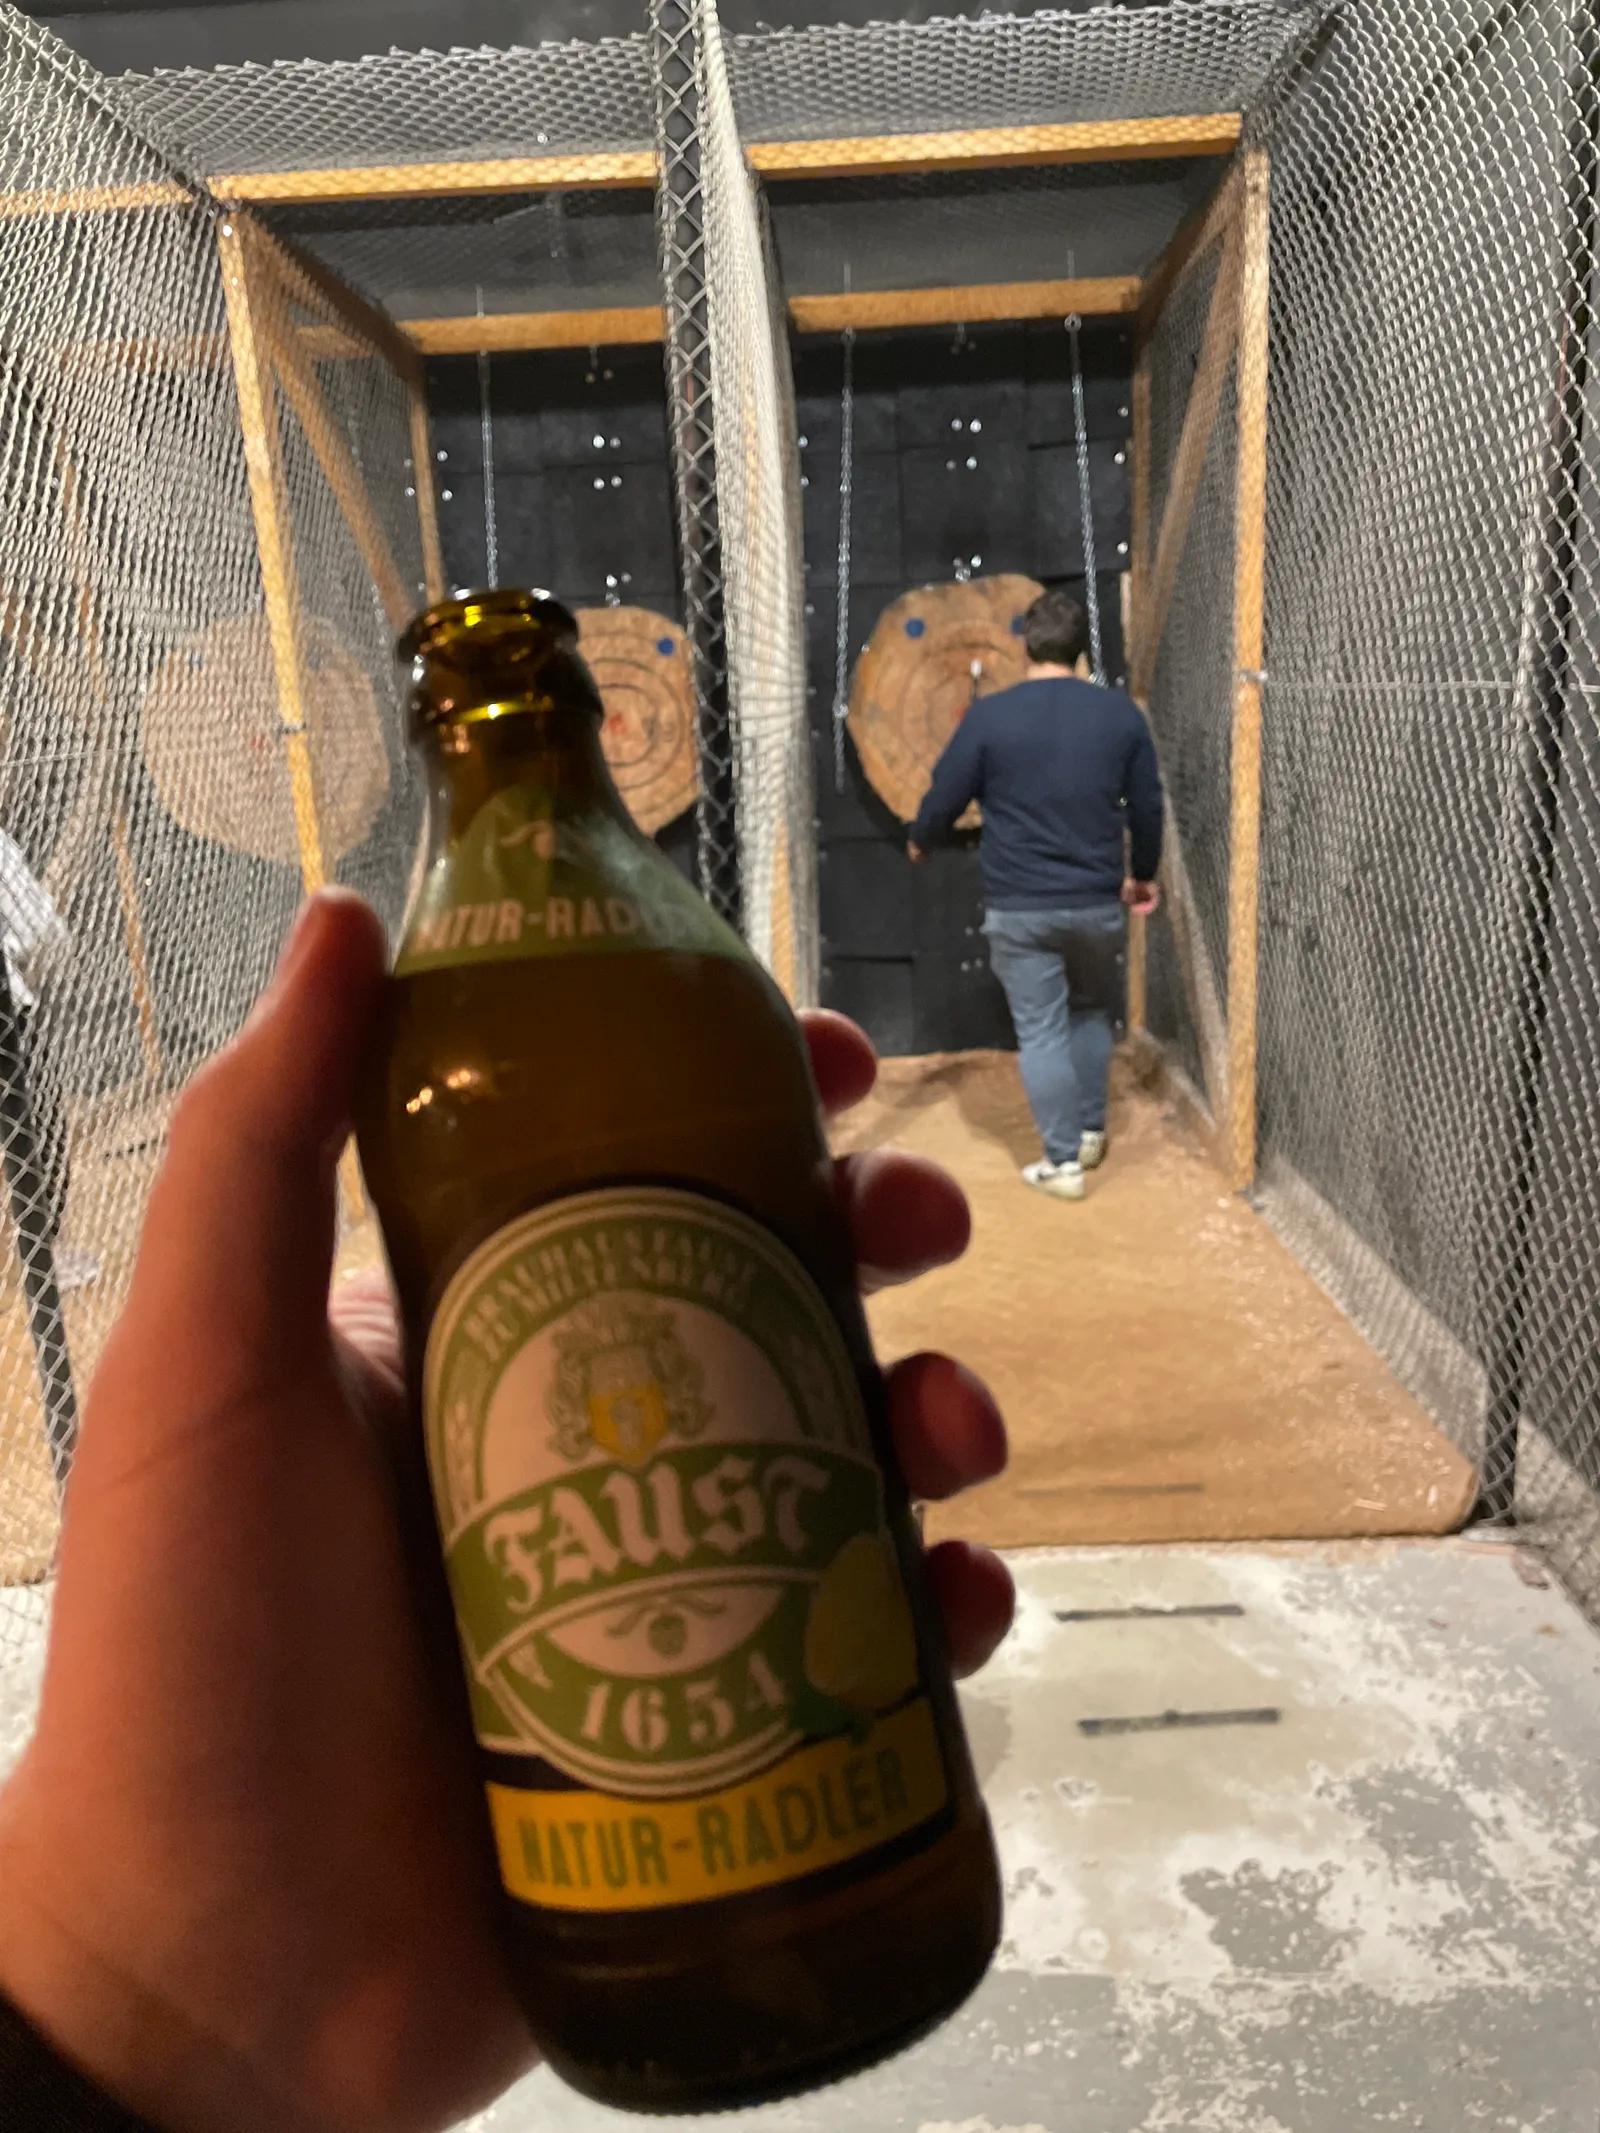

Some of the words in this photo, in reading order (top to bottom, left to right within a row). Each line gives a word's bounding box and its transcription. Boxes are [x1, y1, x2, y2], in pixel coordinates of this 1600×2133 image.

[483, 1456, 830, 1612] FAUST
[581, 1650, 786, 1753] 1654
[515, 1746, 908, 1889] NATUR-RADLER
